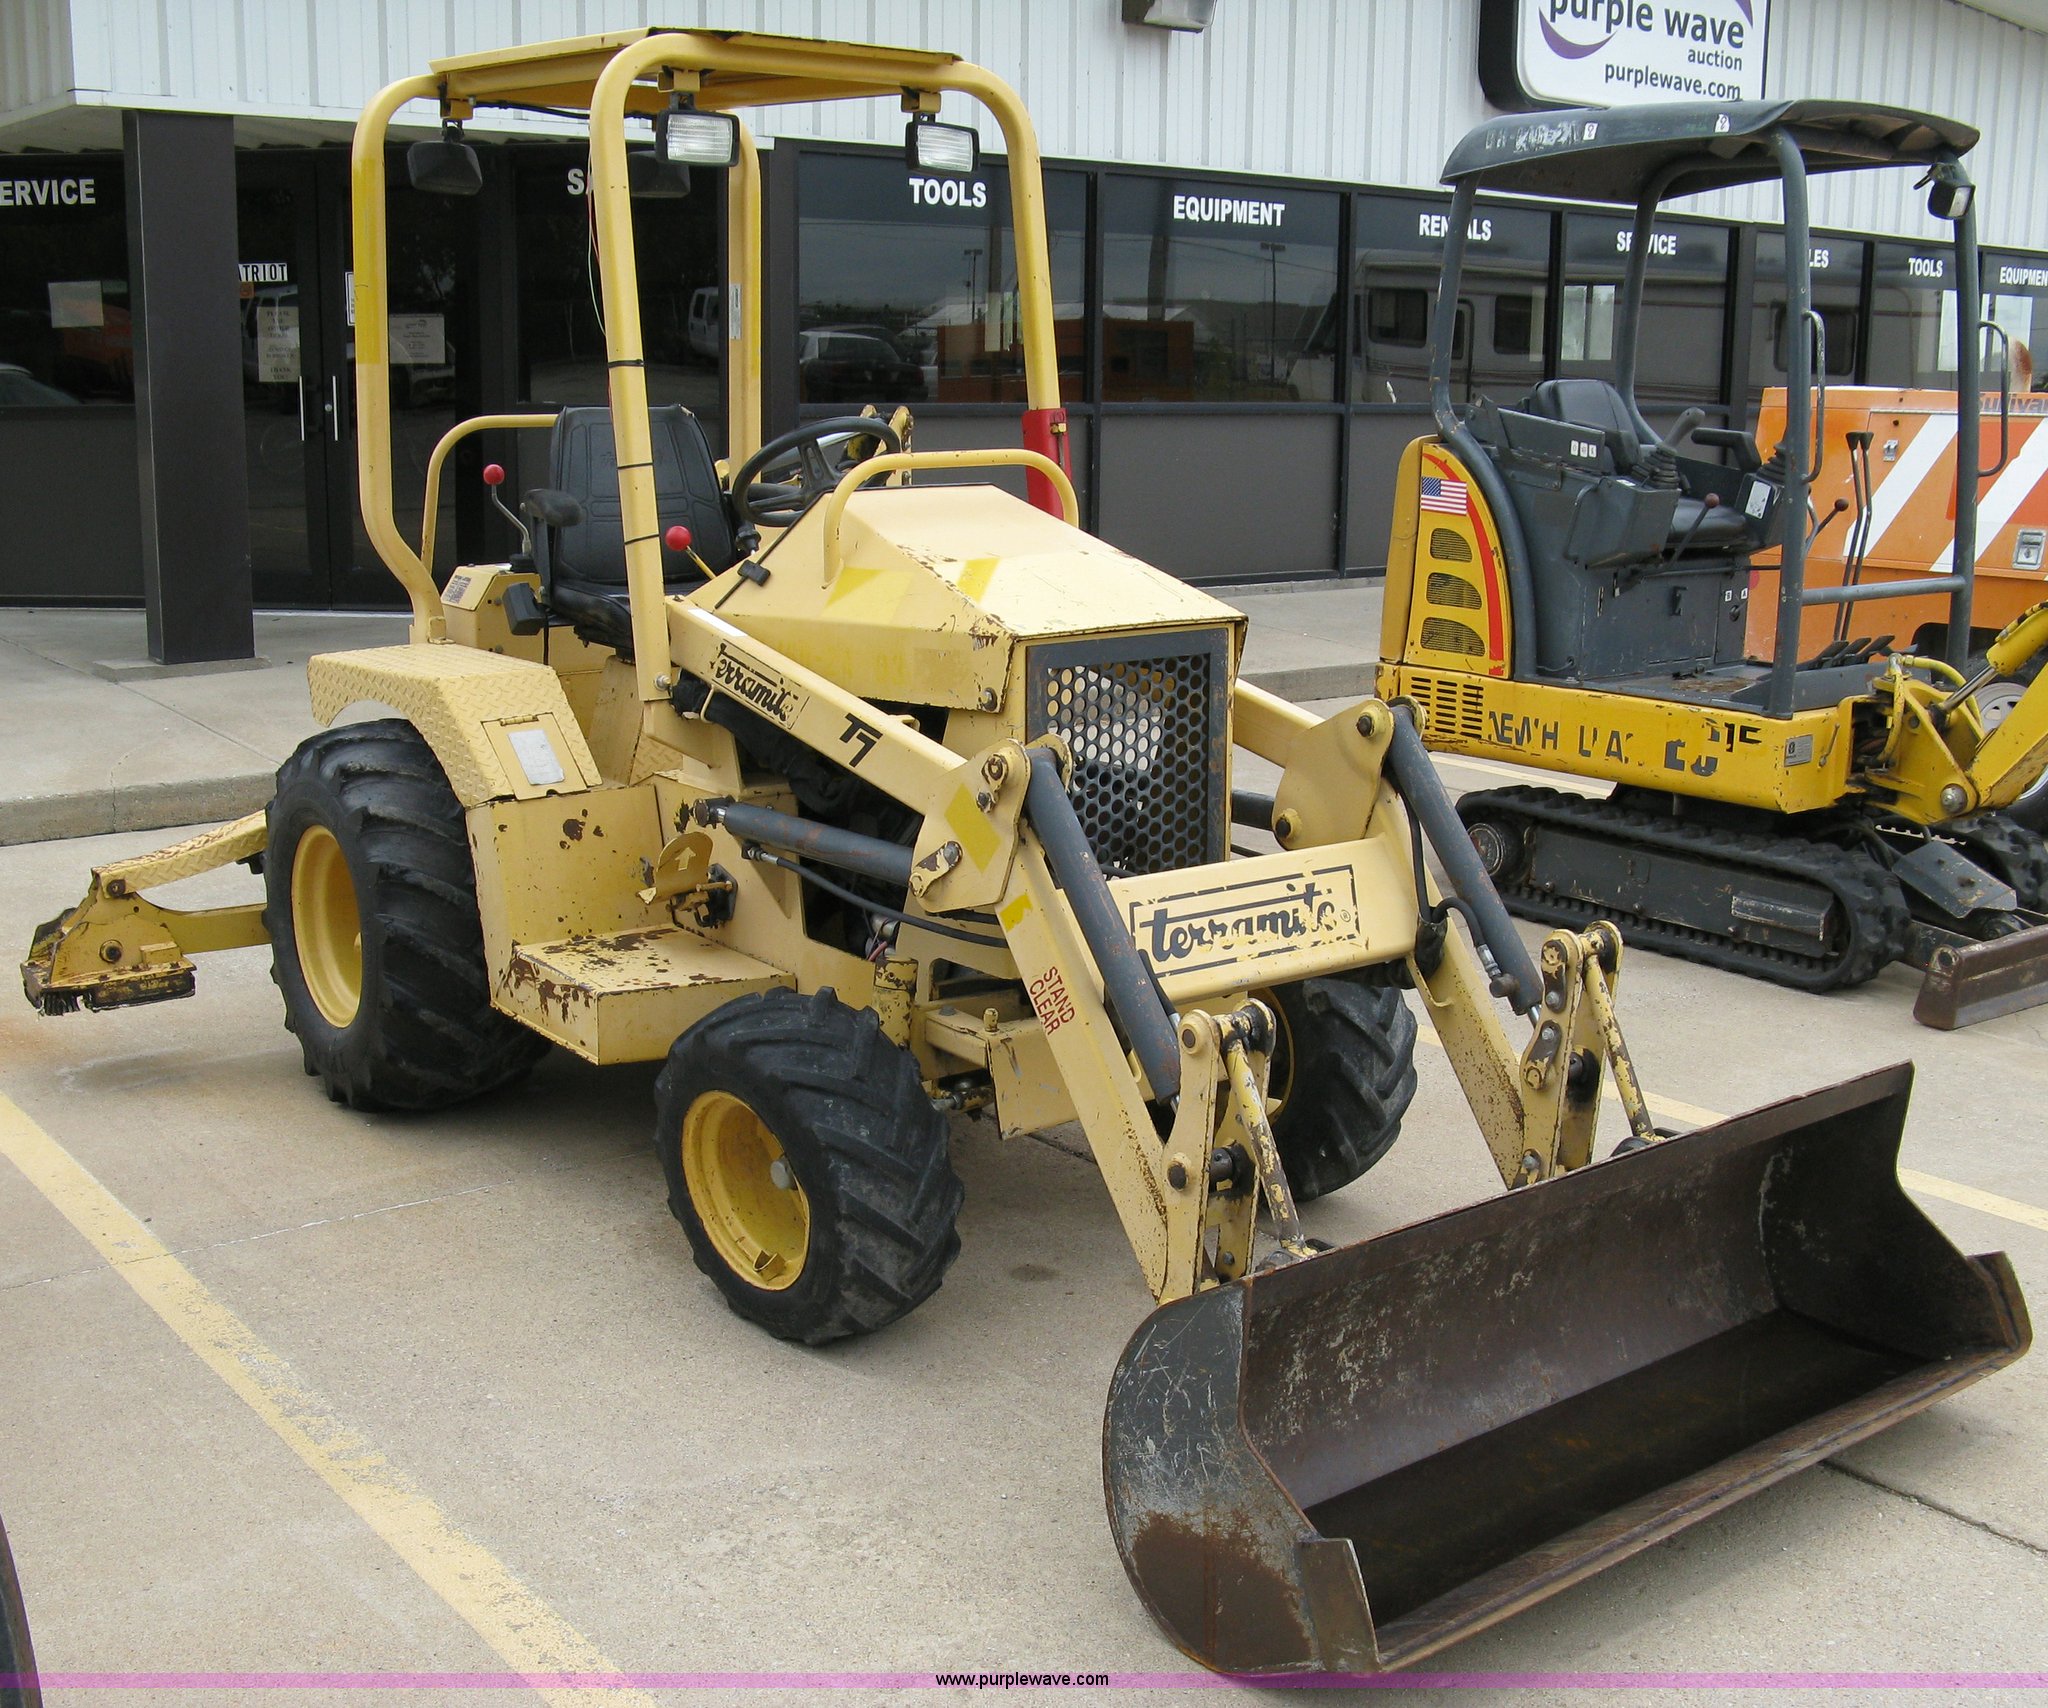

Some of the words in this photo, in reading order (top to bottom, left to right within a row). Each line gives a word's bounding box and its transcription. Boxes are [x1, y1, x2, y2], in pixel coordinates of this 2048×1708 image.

[1550, 0, 1653, 34] purple
[1664, 8, 1744, 49] wave
[1688, 48, 1742, 71] auction
[1605, 63, 1741, 100] purplewave.com
[908, 177, 987, 208] TOOLS
[1173, 195, 1285, 226] EQUIPMENT
[1419, 214, 1492, 241] RENLS
[1616, 231, 1677, 255] SEVICE
[1808, 249, 1829, 268] LES
[1908, 257, 1943, 278] TOOLS
[239, 264, 287, 281] TRIOT
[1999, 266, 2048, 288] EQUIPMEN
[1030, 979, 1061, 1036] CLEAR
[1043, 966, 1075, 1024] STAND
